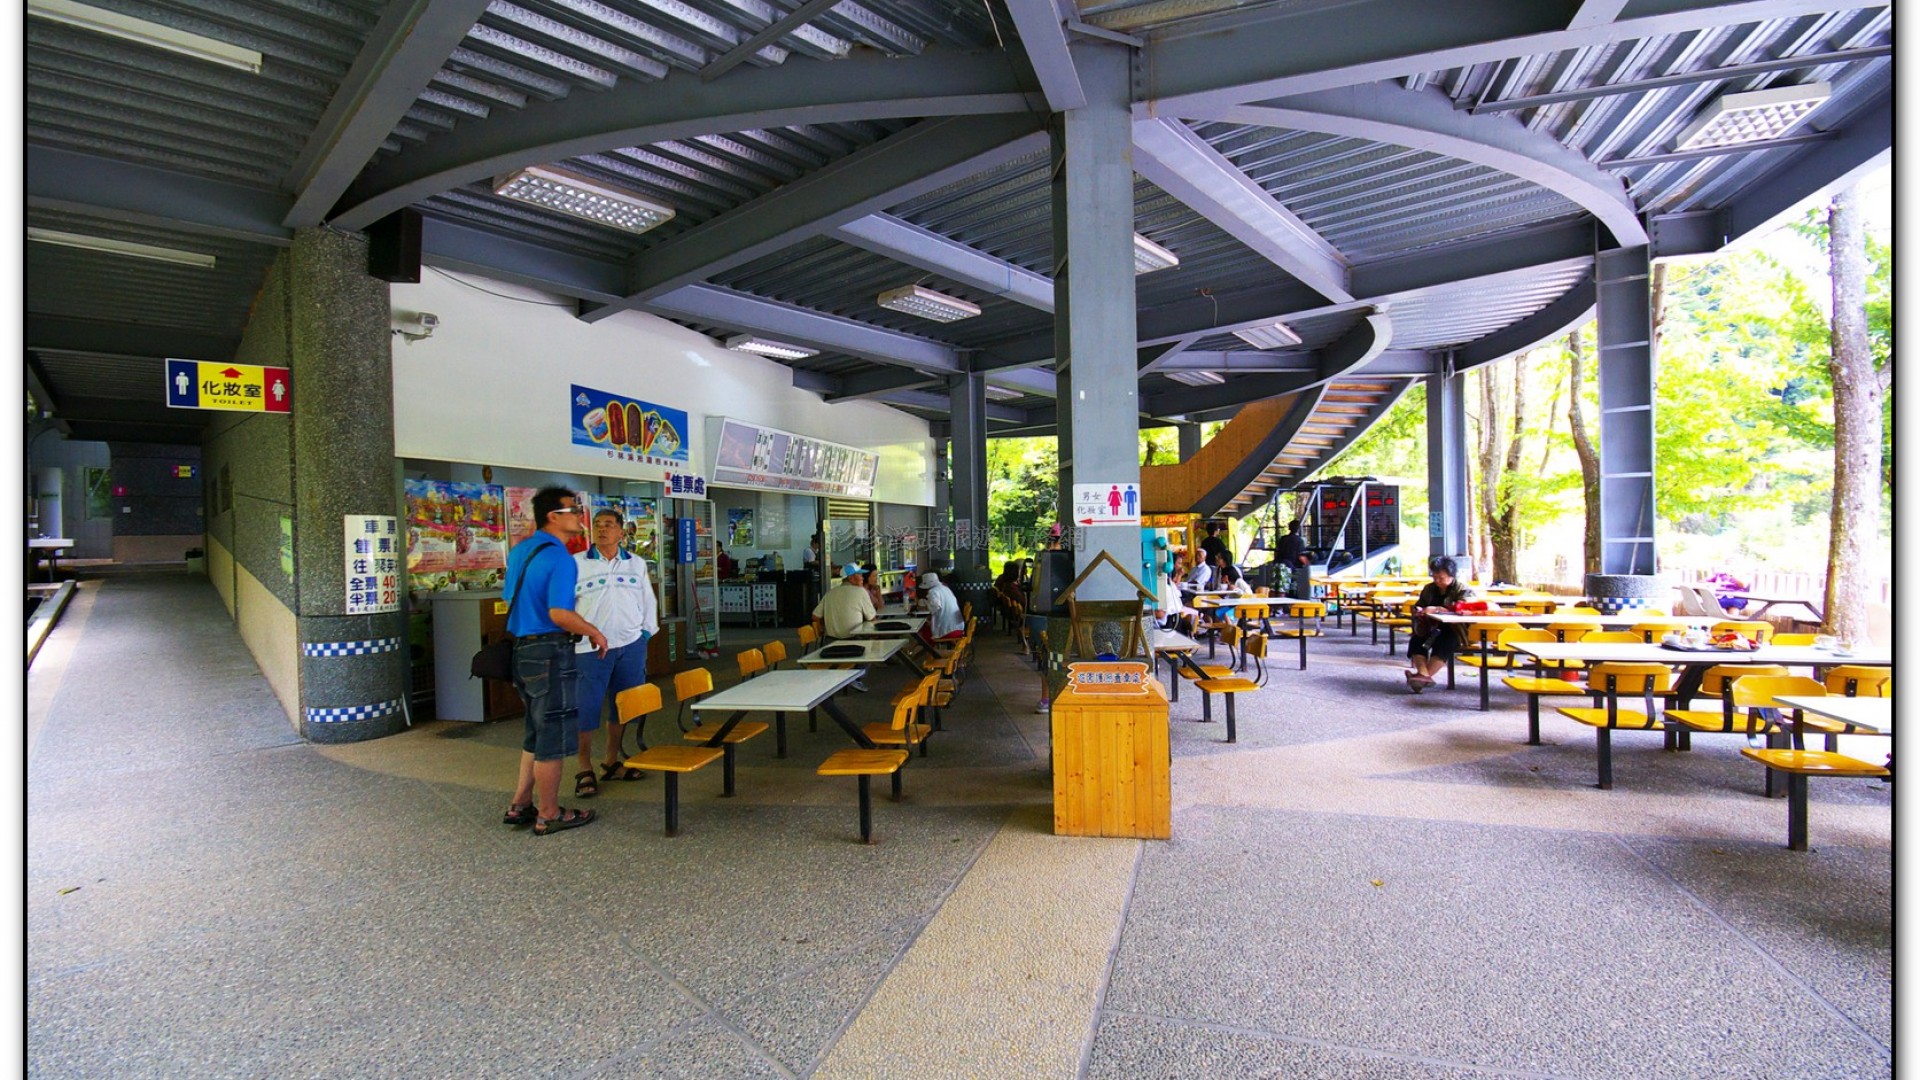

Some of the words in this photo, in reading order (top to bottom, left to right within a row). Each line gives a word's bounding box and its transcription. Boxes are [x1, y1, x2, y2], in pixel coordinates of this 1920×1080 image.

[202, 380, 262, 398] 化妝室
[671, 473, 705, 496] 售票處
[1083, 491, 1102, 501] 男女
[349, 575, 378, 592] 全票
[349, 591, 379, 607] 半票
